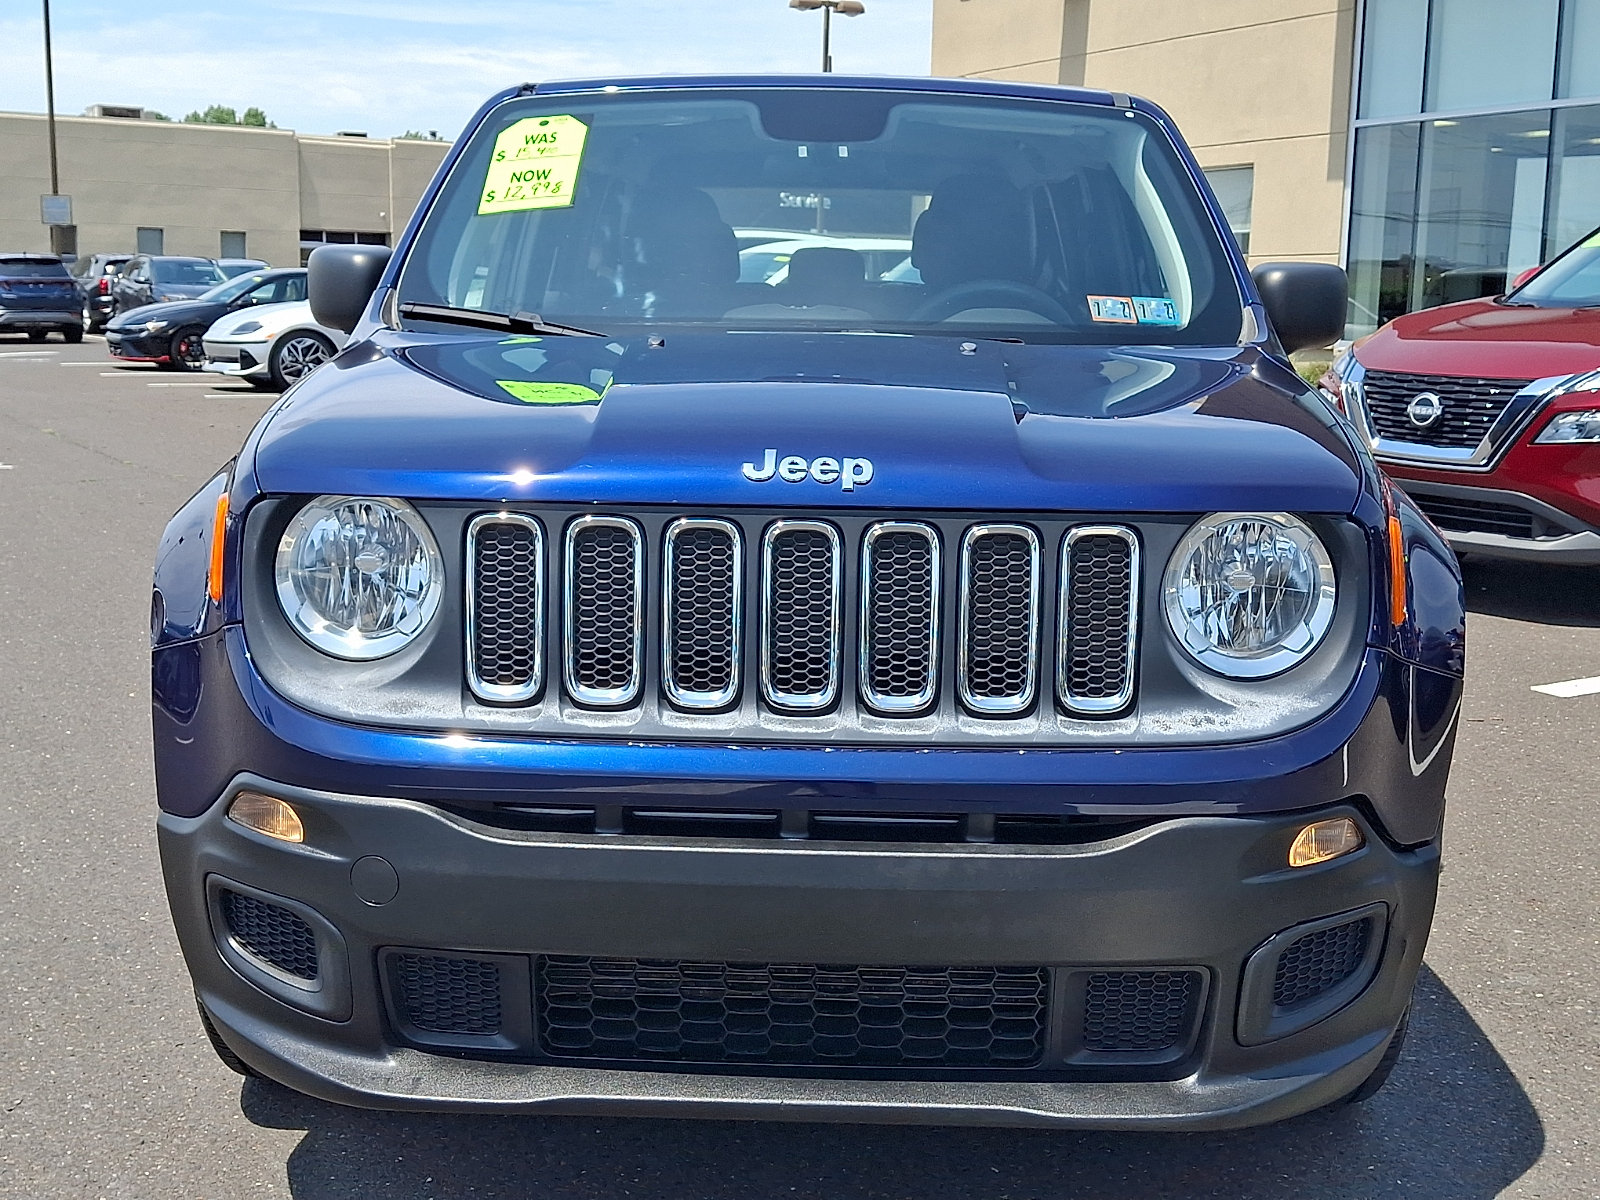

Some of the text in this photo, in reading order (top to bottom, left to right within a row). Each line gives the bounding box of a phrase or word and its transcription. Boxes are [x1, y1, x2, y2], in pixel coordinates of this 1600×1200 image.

[525, 131, 558, 145] WAS
[496, 150, 506, 162] $
[510, 168, 552, 183] NOW
[485, 181, 564, 203] $ 12,998
[742, 448, 874, 492] Jeep
